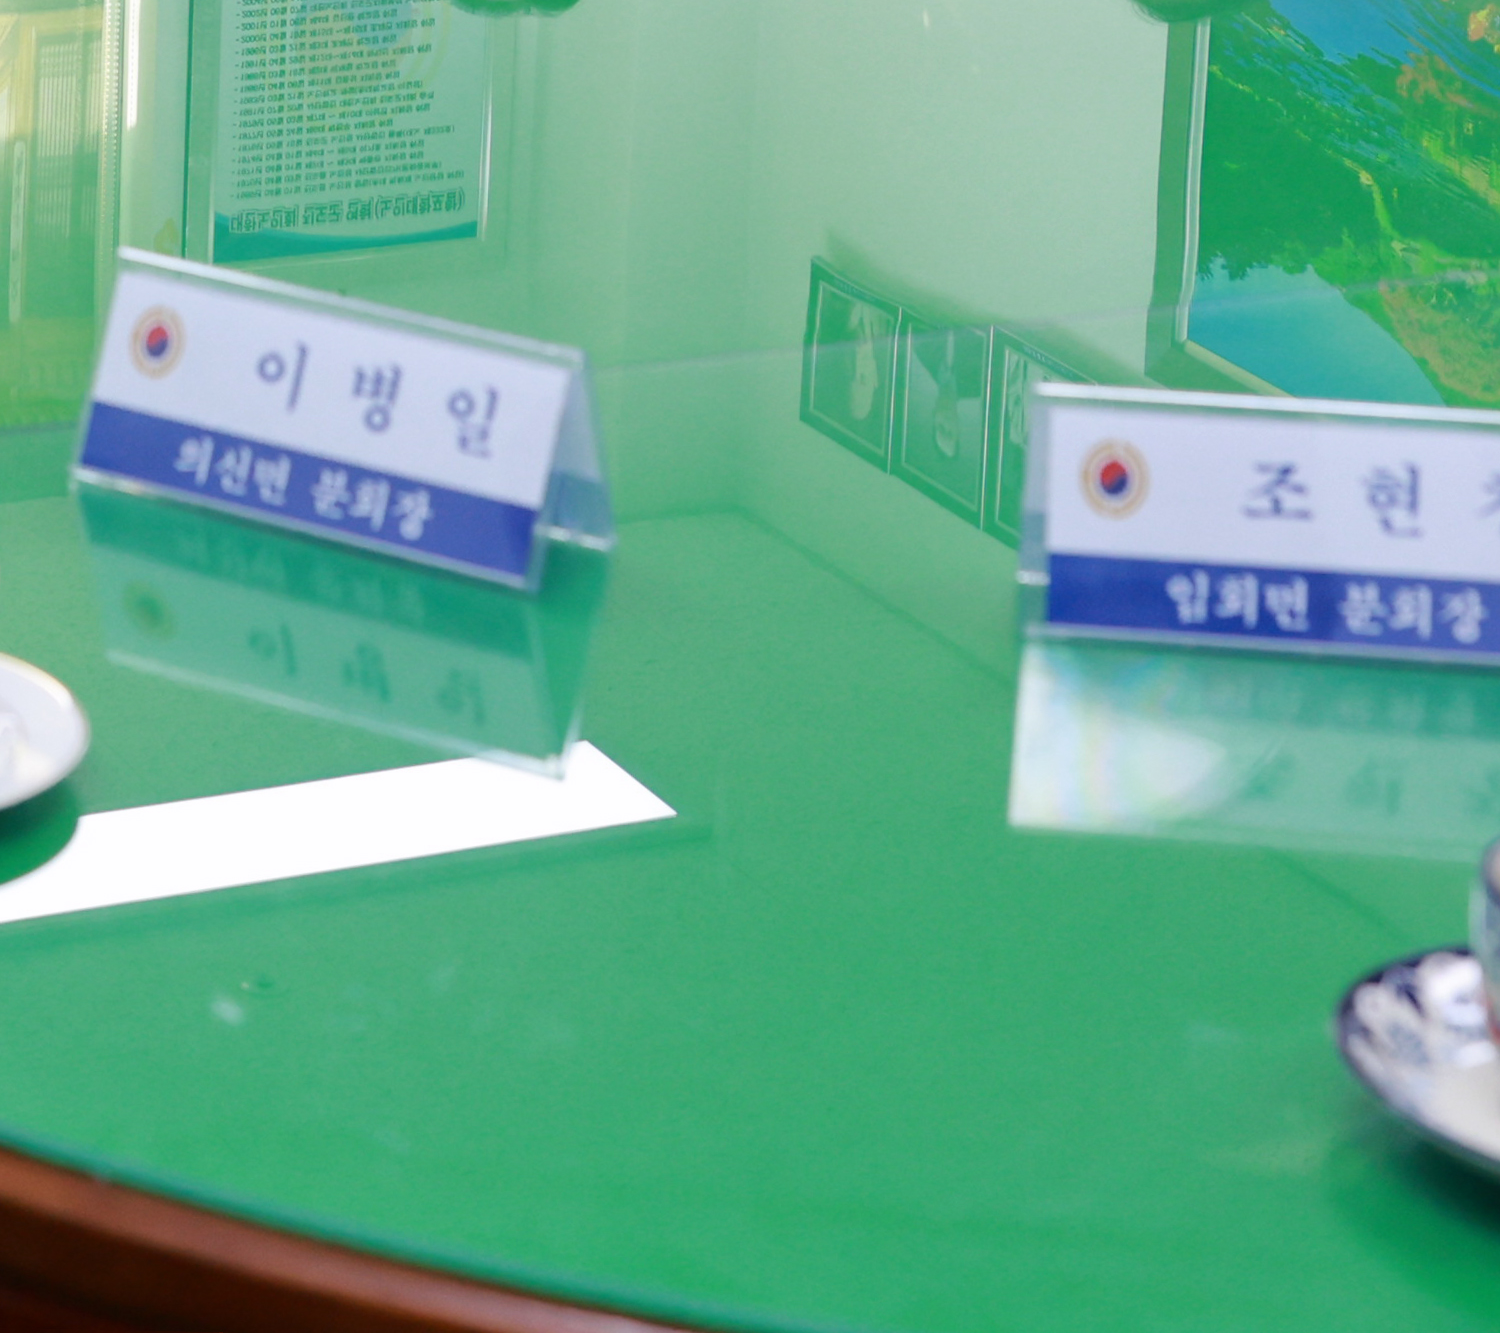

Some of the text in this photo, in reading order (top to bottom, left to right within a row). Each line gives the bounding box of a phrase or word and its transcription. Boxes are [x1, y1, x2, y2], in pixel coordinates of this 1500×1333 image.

[173, 435, 436, 542] 의신면 분회장
[1165, 569, 1488, 645] 임회면 분회장
